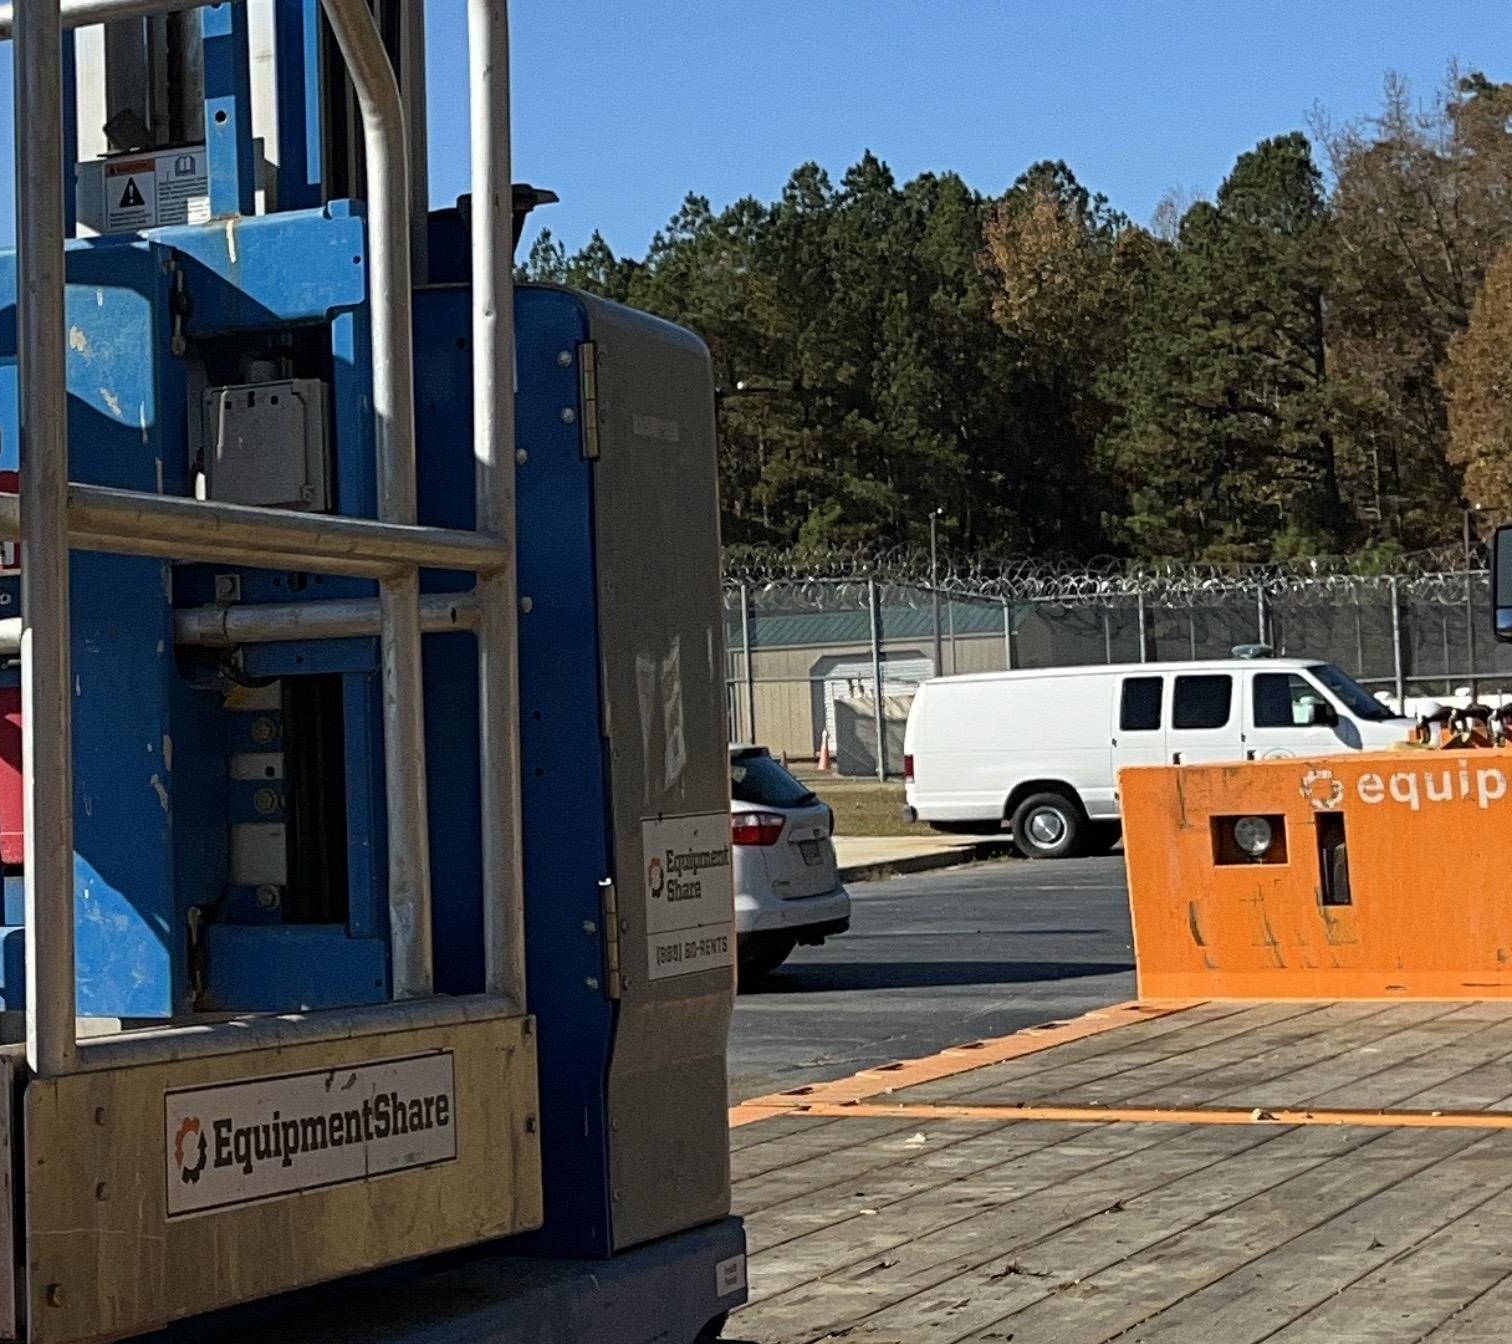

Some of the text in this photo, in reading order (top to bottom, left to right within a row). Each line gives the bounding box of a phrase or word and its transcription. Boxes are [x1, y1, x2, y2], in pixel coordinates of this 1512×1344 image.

[1357, 759, 1507, 811] equip
[666, 845, 730, 876] Equipment
[667, 879, 702, 903] Share
[213, 1091, 450, 1175] EquipmentShare
